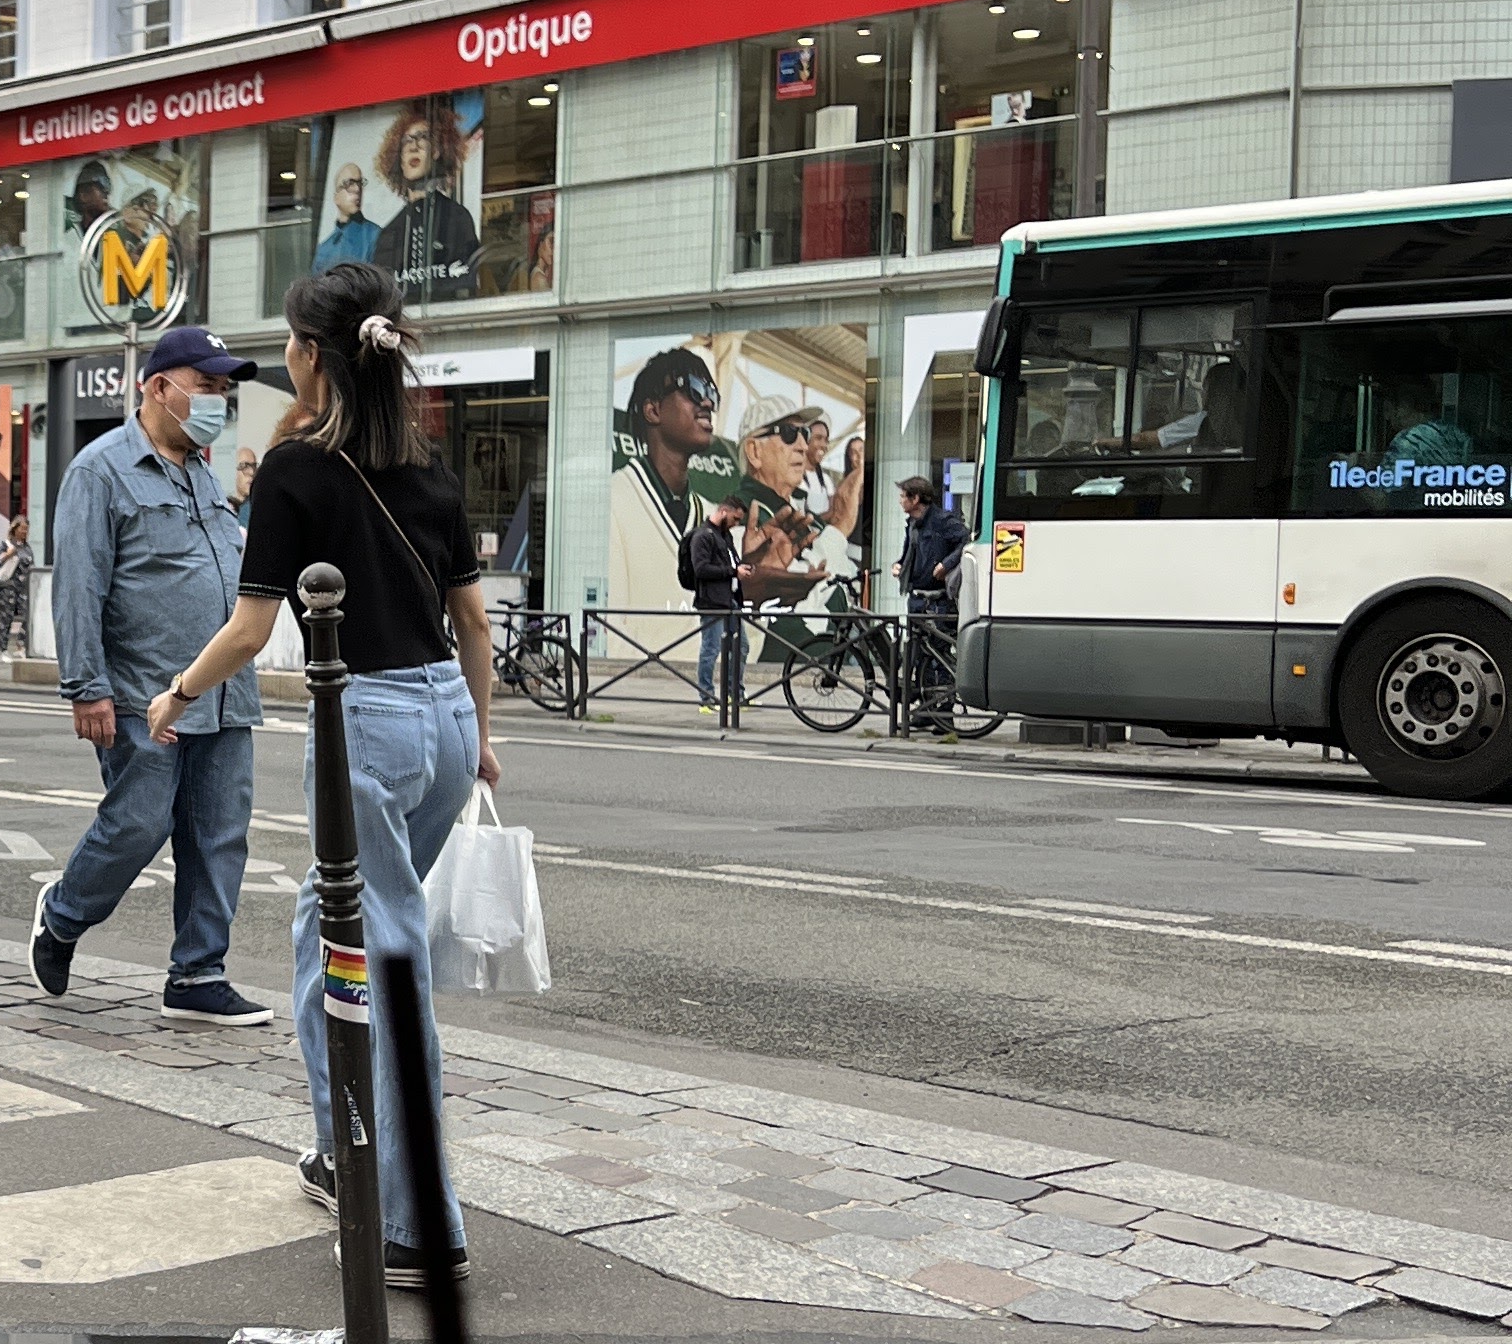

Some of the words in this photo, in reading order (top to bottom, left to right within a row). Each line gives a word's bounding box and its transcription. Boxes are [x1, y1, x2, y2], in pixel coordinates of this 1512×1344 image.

[457, 10, 593, 68] Optique
[19, 102, 119, 146] Lentilles
[125, 93, 157, 126] de
[163, 70, 265, 121] contact
[102, 230, 169, 313] M
[1423, 487, 1505, 507] mobilités
